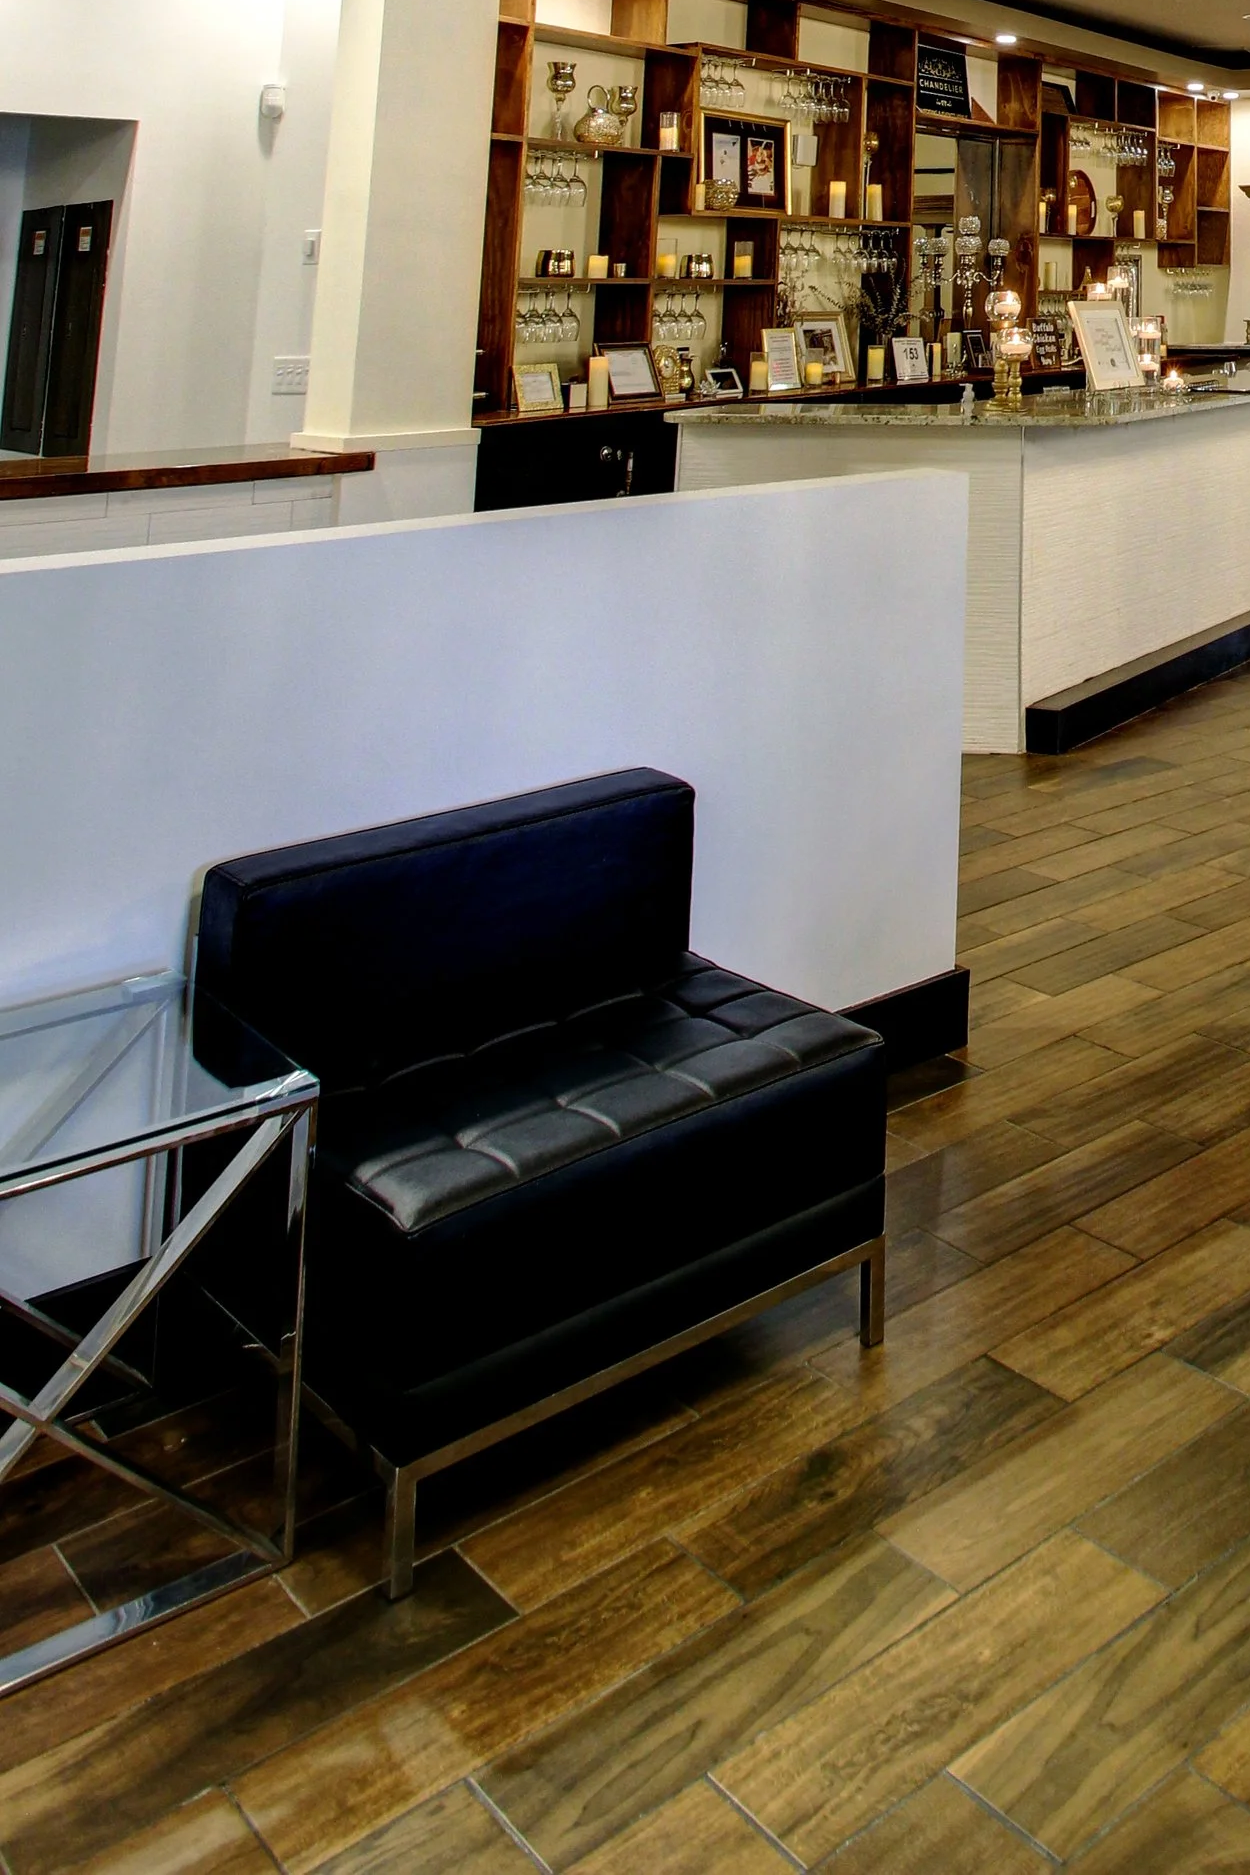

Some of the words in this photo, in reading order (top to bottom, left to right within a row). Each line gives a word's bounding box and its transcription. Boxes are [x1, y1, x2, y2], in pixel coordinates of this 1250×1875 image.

[919, 79, 963, 94] CHANDELIER
[1032, 322, 1054, 333] Buffalo
[1033, 333, 1056, 343] Chicken
[903, 347, 919, 360] 153
